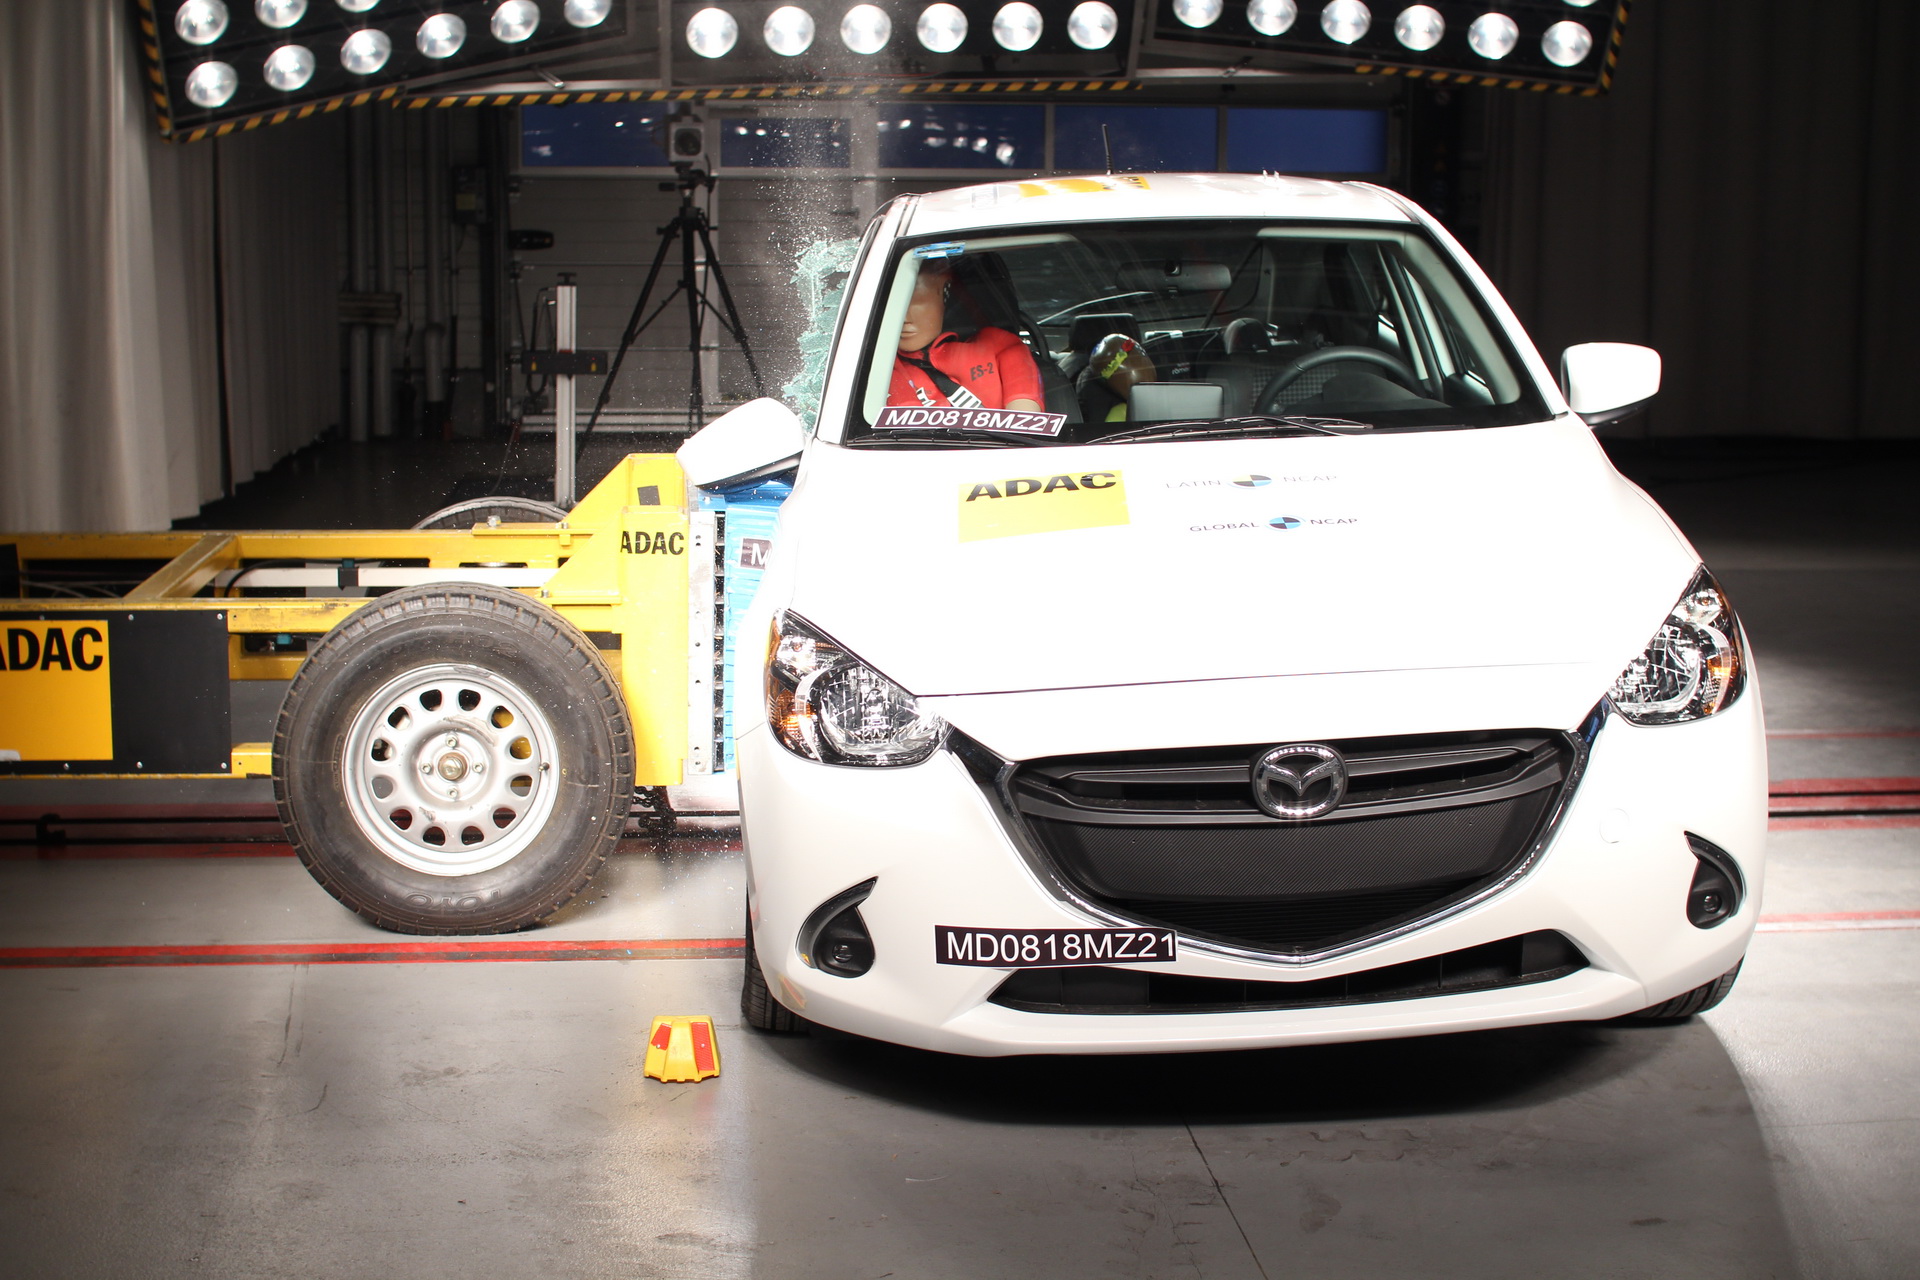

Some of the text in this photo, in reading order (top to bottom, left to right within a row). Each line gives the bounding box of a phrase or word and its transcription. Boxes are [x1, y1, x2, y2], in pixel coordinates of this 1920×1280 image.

[969, 362, 995, 382] ES-2
[885, 410, 1062, 433] MD0818MZ21
[965, 472, 1117, 502] ADAC
[1165, 475, 1338, 489] LATIN NCAP
[1189, 521, 1260, 532] GLOBAL
[620, 530, 685, 556] ADAC
[0, 627, 104, 671] DAC
[947, 931, 1175, 962] MD0818MZ21
